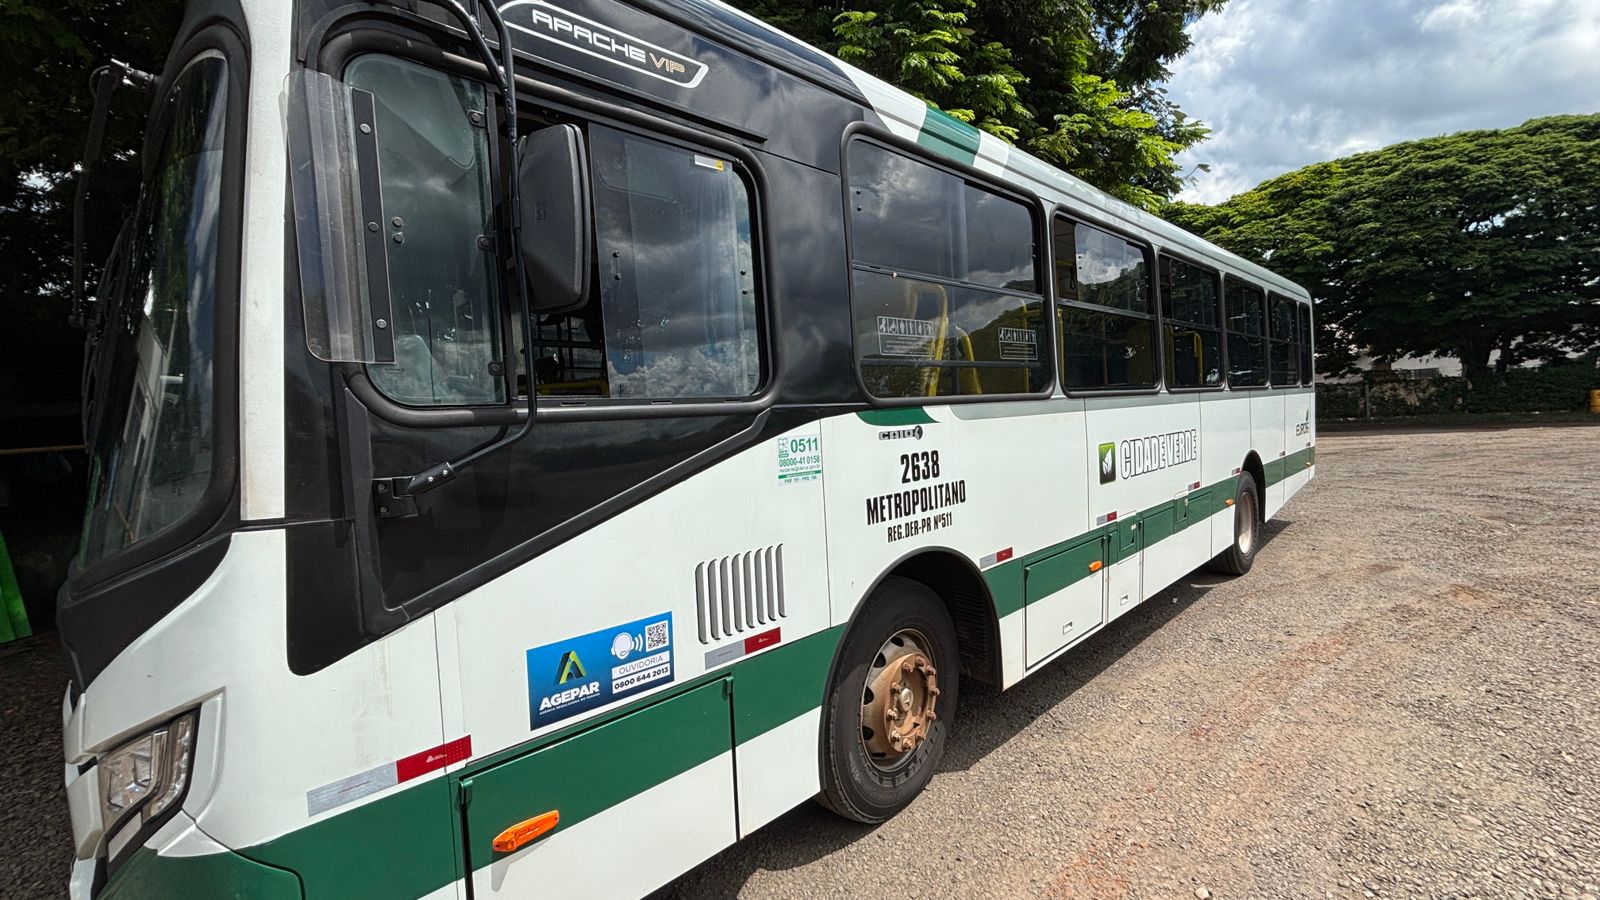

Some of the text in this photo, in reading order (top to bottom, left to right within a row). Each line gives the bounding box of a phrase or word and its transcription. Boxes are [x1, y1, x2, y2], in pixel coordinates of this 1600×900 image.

[532, 9, 685, 73] APACHE VIP
[790, 437, 818, 453] 0511
[900, 450, 940, 484] 2638
[866, 479, 966, 526] METROPOLITANO
[887, 516, 931, 543] REG.DER-PR
[614, 666, 669, 690] 0800 644 2013
[618, 655, 663, 675] OUVIDORIA
[539, 681, 600, 711] AGEPAR
